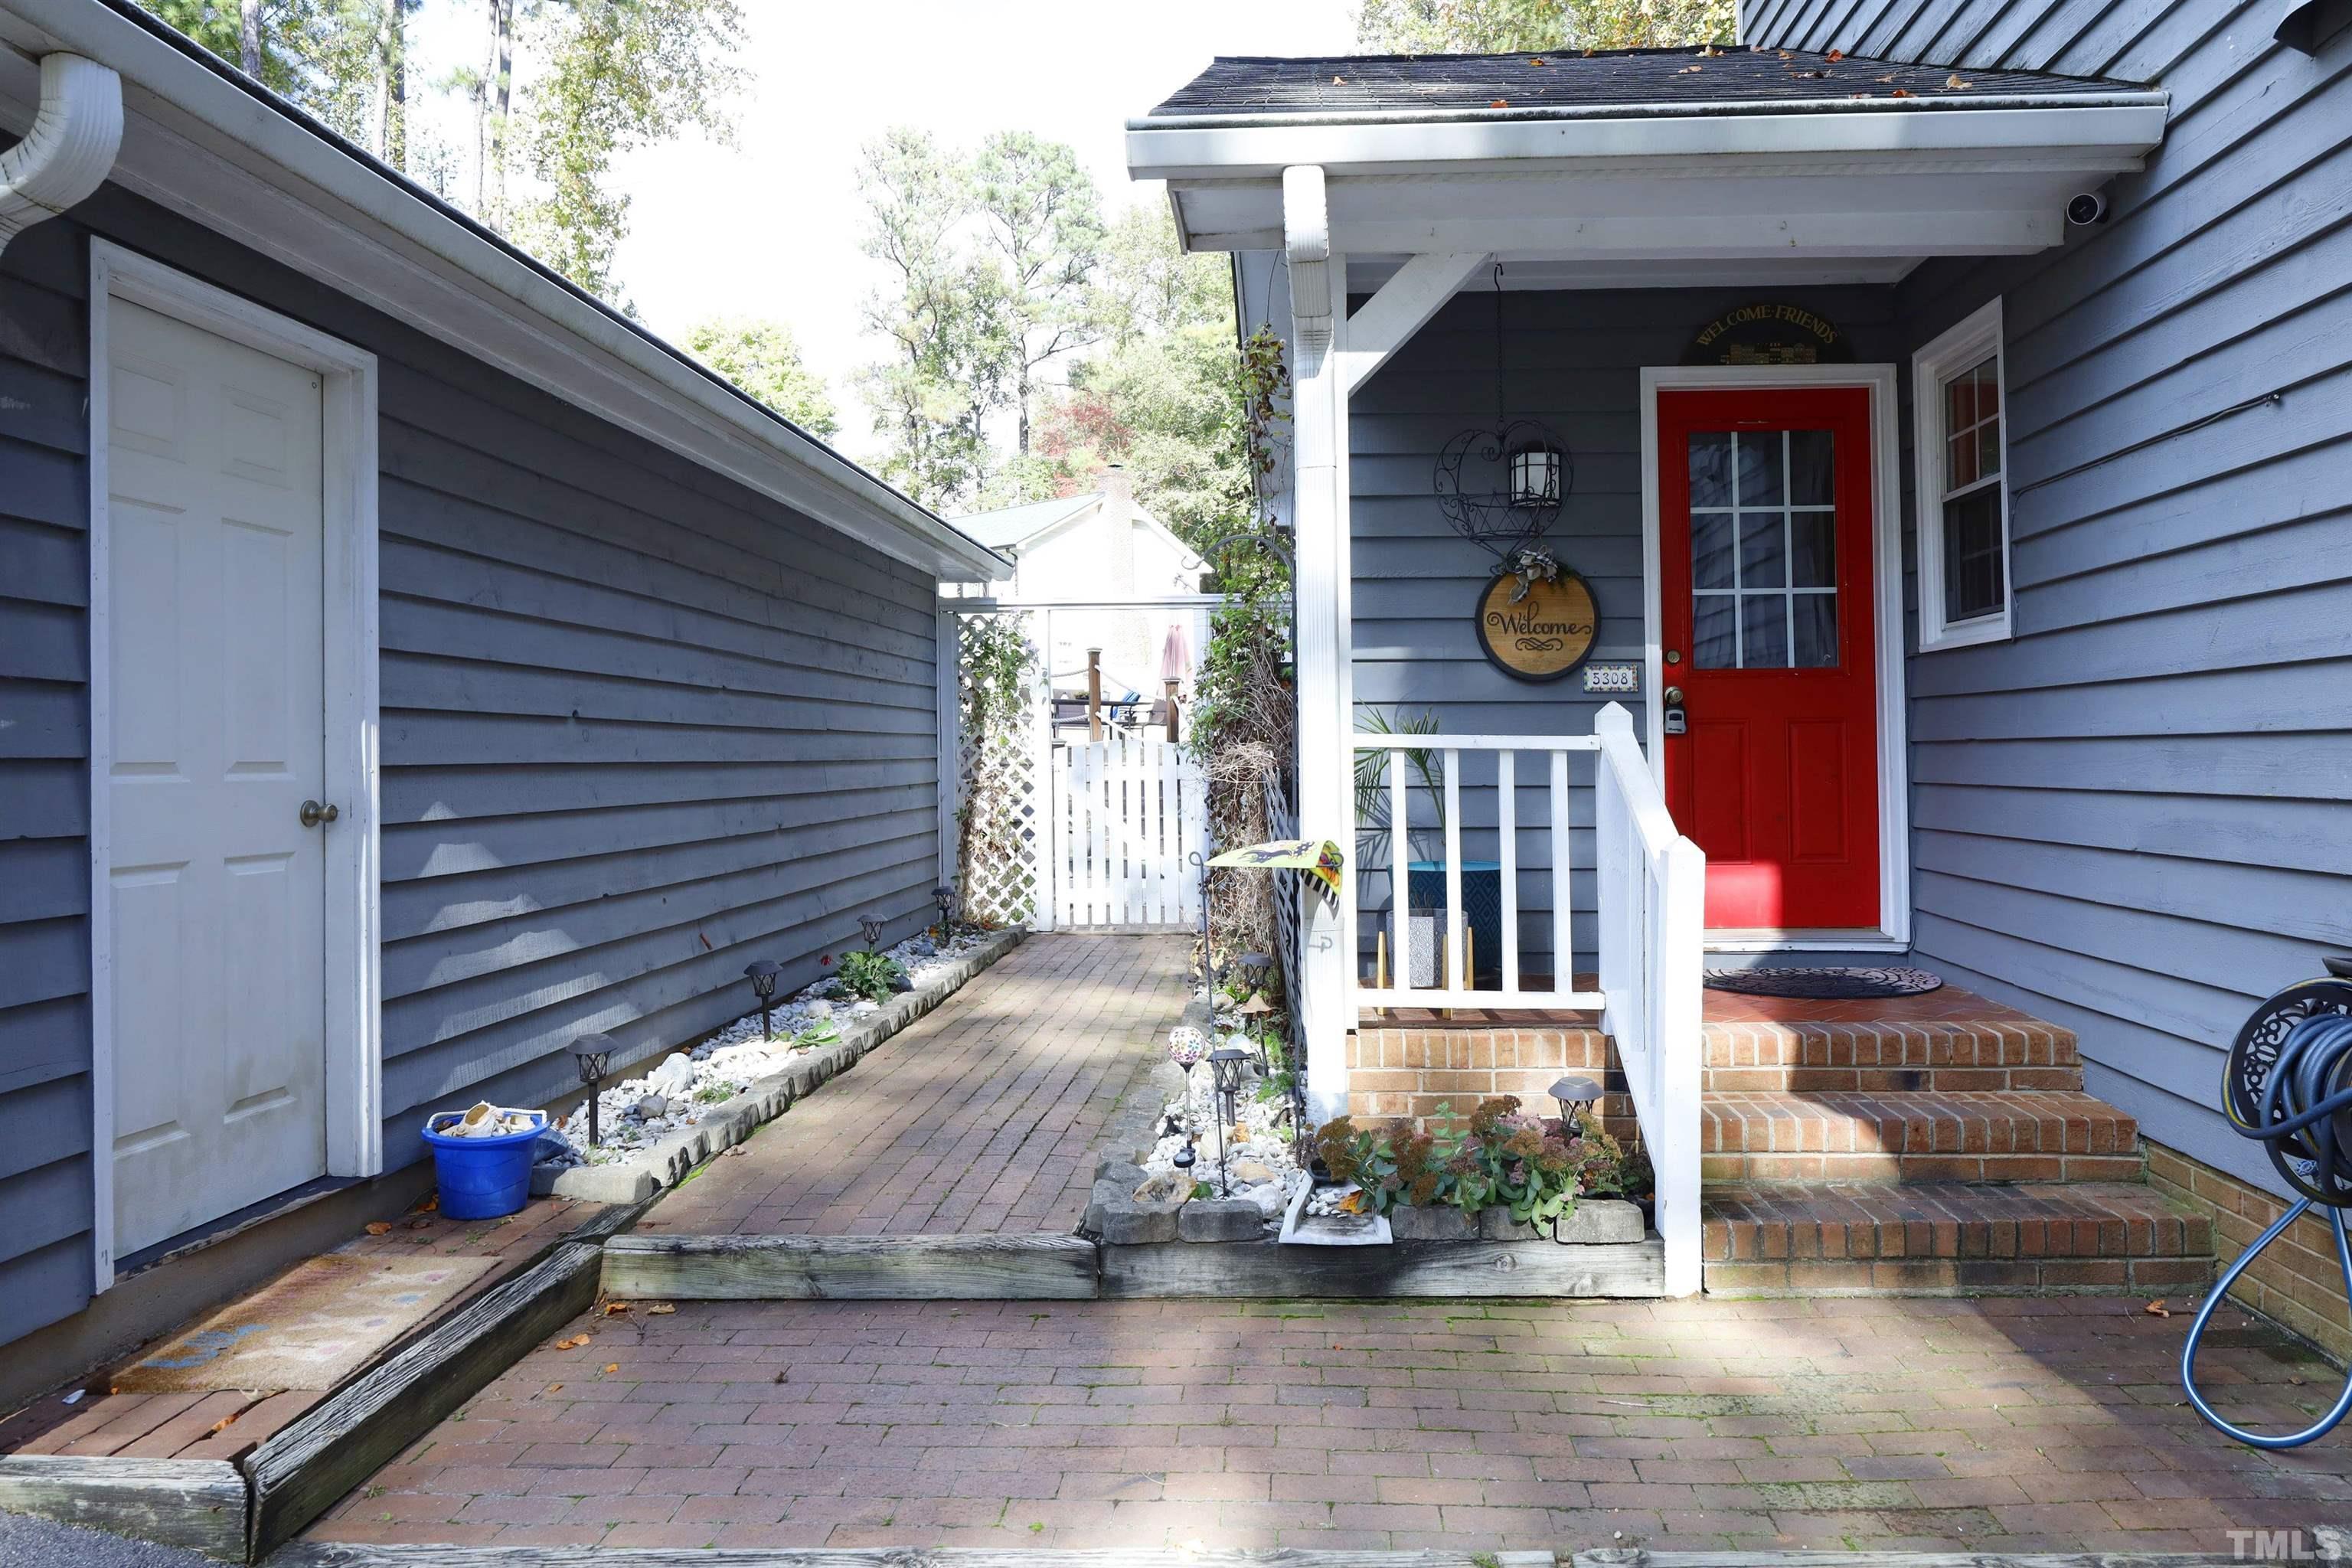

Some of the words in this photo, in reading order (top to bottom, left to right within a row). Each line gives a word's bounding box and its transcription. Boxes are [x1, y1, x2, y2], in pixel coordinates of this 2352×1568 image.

[1697, 305, 1772, 345] WELCOME
[1775, 305, 1838, 344] FRIENDS
[1486, 601, 1592, 635] Welcome
[1592, 672, 1628, 685] 5308
